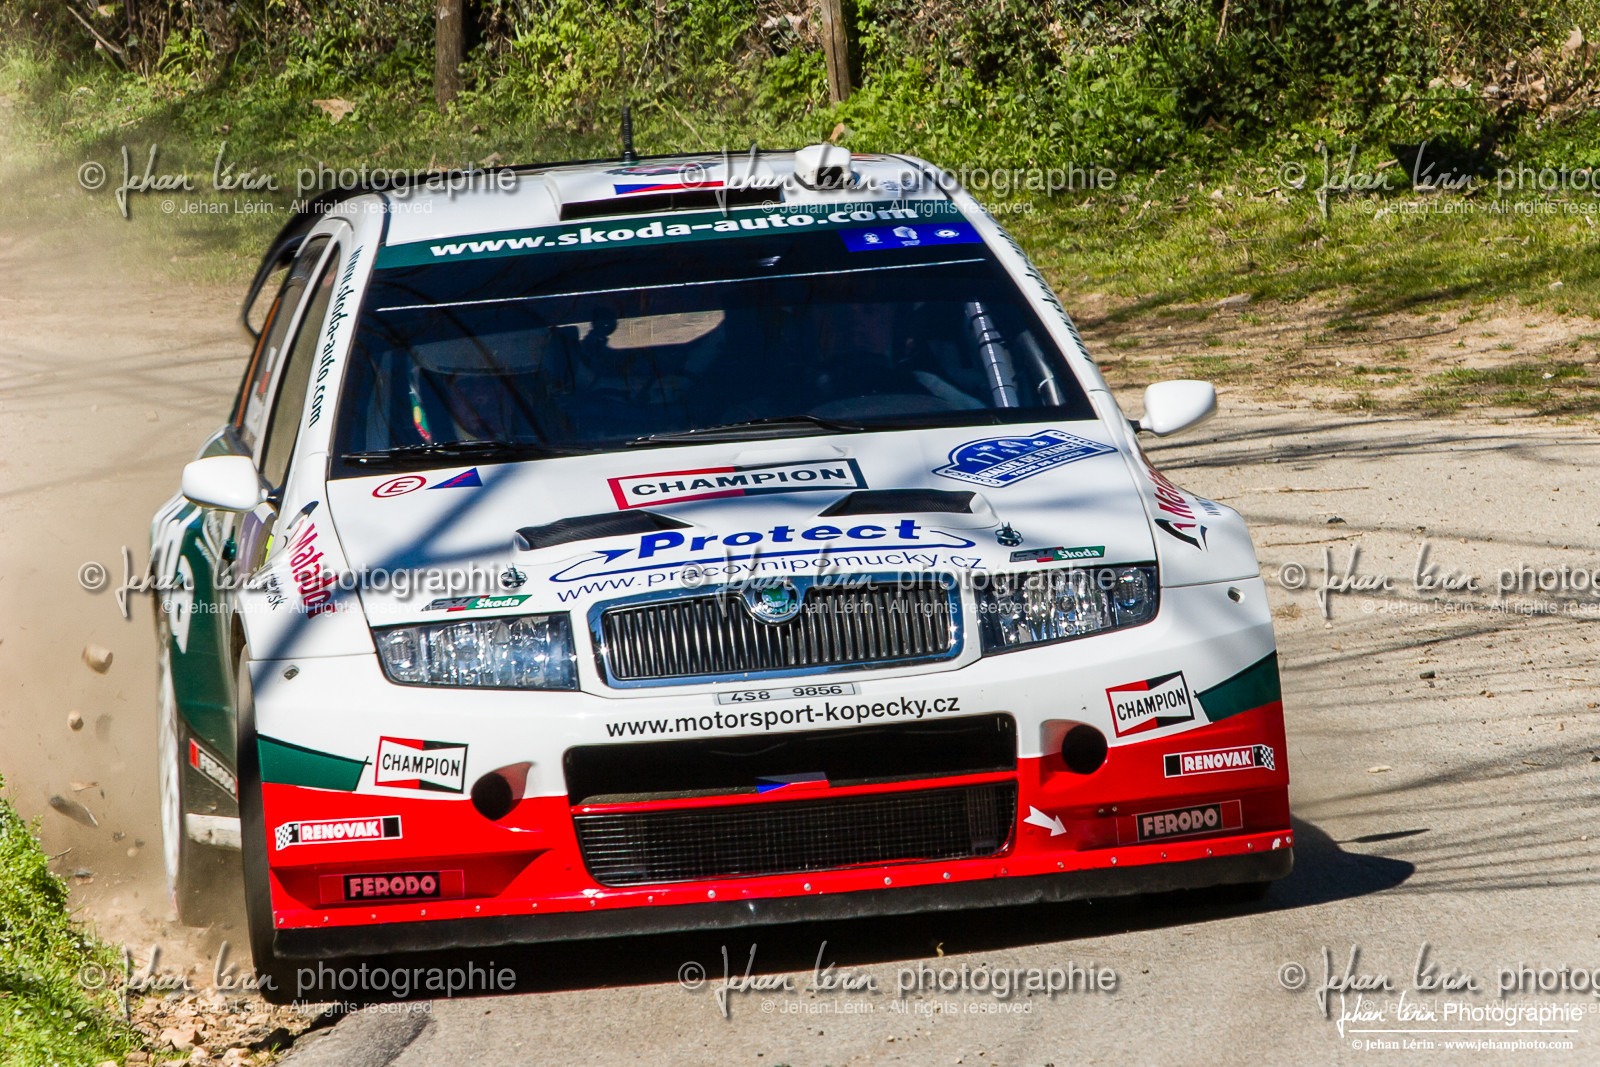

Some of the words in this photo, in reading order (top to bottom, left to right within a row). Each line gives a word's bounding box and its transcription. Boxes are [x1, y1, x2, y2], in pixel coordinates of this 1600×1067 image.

[430, 207, 920, 257] www.skoda-auto.com
[308, 245, 364, 429] www.skoda-auto.com
[978, 460, 1025, 478] RALLYE
[1018, 453, 1041, 463] DE
[631, 468, 847, 495] CHAMPION
[637, 519, 922, 560] Protect
[557, 550, 988, 603] www.pracovnipomucky.cz
[731, 690, 771, 702] 4S8
[792, 685, 843, 697] 9856
[1117, 688, 1186, 721] CHAMPION
[606, 696, 960, 738] www.motorsport-kopecky.cz
[382, 753, 460, 777] CHAMPION
[1184, 750, 1252, 772] RENOVAK
[301, 819, 379, 841] RENOVAK
[1142, 808, 1218, 836] FERODO
[349, 875, 437, 898] FERODO
